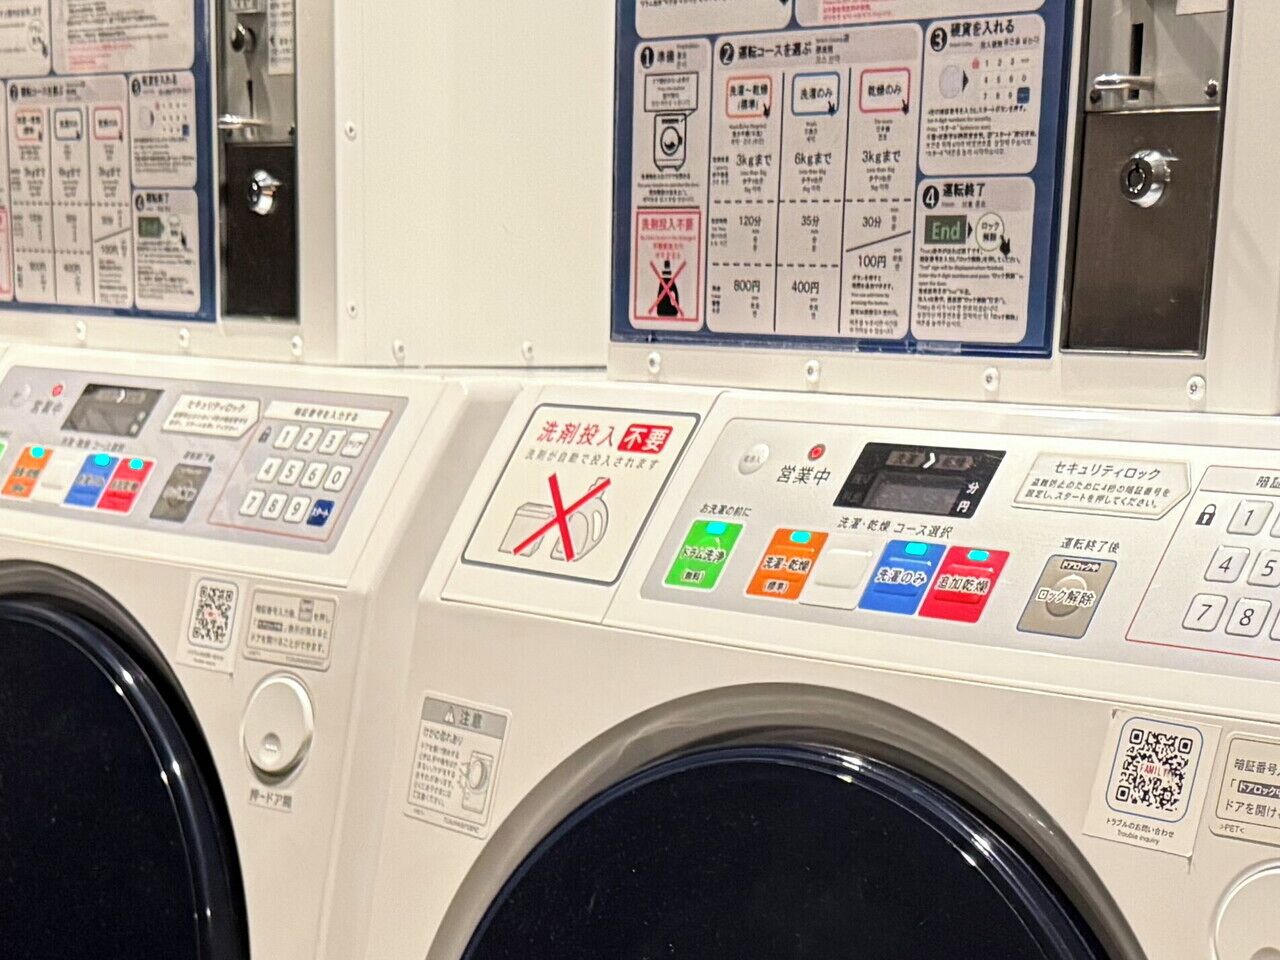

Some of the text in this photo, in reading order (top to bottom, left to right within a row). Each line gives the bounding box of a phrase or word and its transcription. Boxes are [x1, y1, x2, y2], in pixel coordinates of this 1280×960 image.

[951, 19, 1015, 37] 硬貨を入れる
[739, 41, 812, 59] 運転コースを選ぶ
[794, 151, 832, 166] 6kgまで
[862, 148, 901, 164] 3kgまで
[943, 183, 985, 198] 運転終了
[739, 215, 761, 227] 120分
[801, 215, 820, 227] 35分
[862, 216, 882, 228] 30分
[932, 220, 960, 241] End
[858, 255, 887, 269] 100円
[734, 279, 761, 293] 800円
[792, 281, 819, 295] 400円
[285, 430, 292, 443] 1
[303, 433, 313, 446] 2
[326, 435, 336, 448] 3
[536, 420, 670, 451] 洗剤投入 不要
[286, 465, 296, 478] 5
[309, 467, 318, 481] 6
[332, 471, 341, 484] 0
[776, 465, 831, 486] 営業中
[1055, 461, 1161, 480] セキュリティロック
[966, 481, 980, 495] 分
[247, 496, 257, 509] 7
[293, 502, 302, 515] 9
[956, 500, 970, 513] 円
[1244, 510, 1254, 527] 1
[893, 522, 954, 540] コース選択
[1060, 537, 1120, 554] 運転終了後
[1219, 556, 1233, 573] 4
[1262, 560, 1277, 577] 5
[876, 568, 926, 586] 洗濯のみ
[937, 575, 989, 593] 追加乾燥
[1038, 588, 1094, 606] ロック解除
[1198, 604, 1212, 622] 7
[1240, 608, 1255, 626] 8
